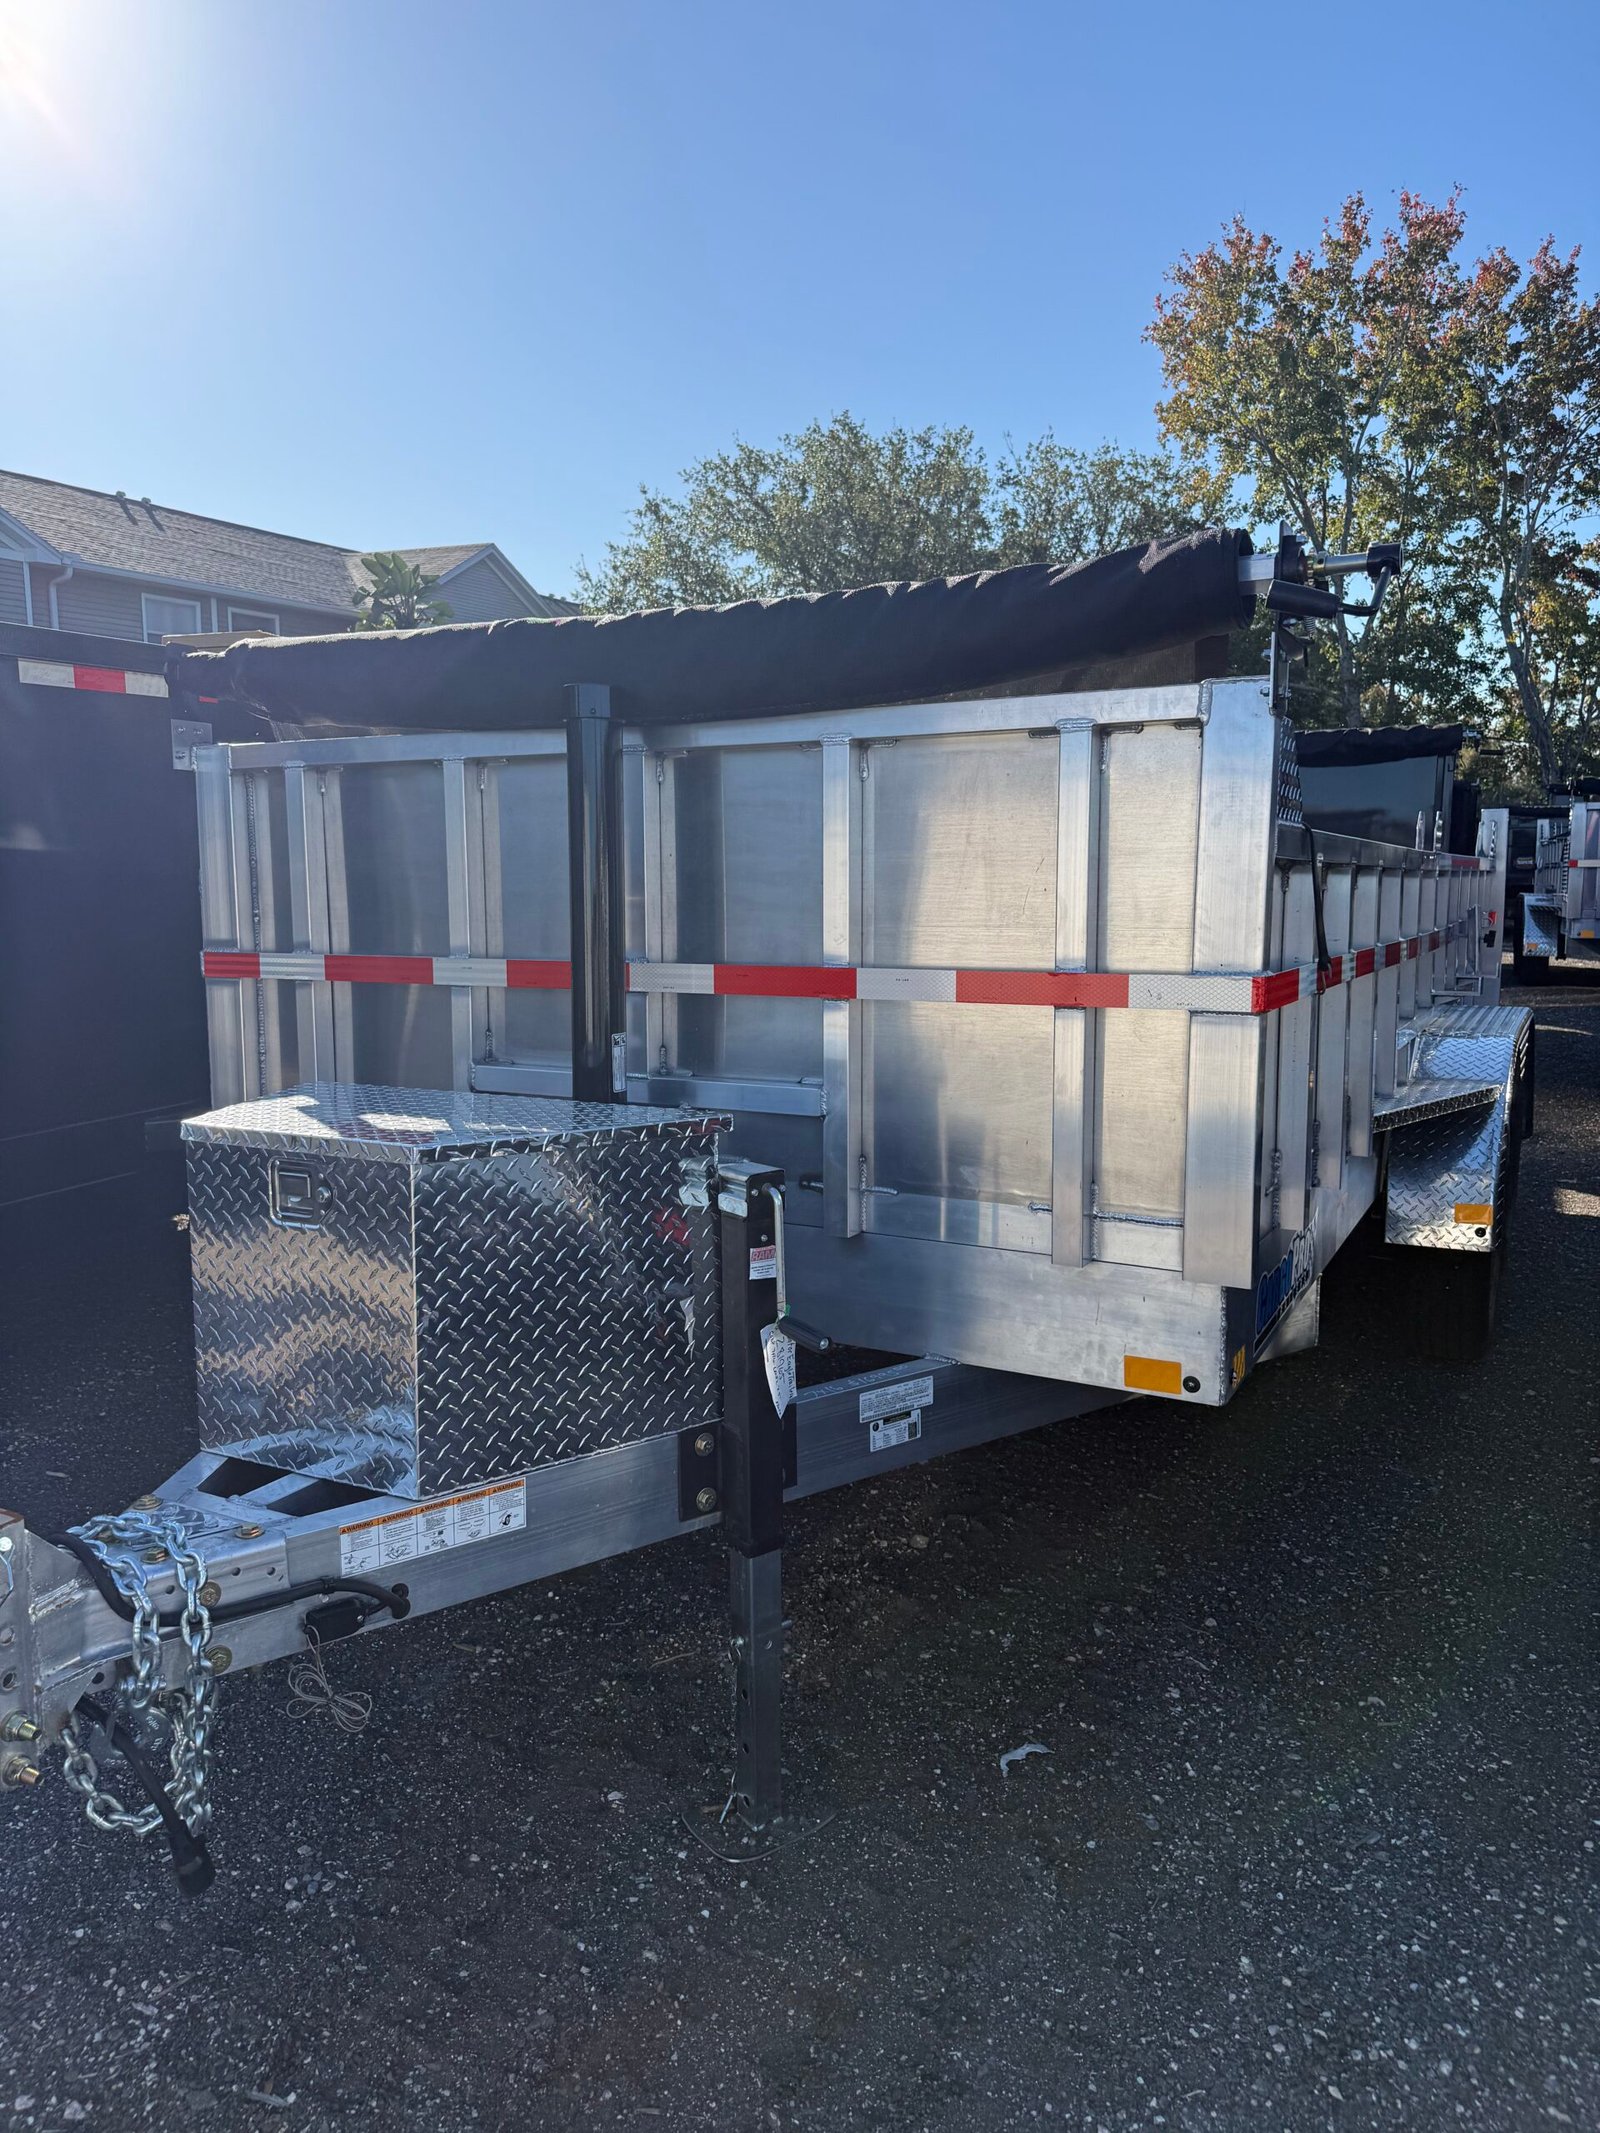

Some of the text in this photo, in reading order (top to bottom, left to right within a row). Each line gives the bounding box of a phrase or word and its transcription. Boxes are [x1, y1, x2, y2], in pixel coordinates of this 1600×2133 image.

[496, 1481, 521, 1492] WARNING
[461, 1490, 487, 1501] WARNING
[425, 1500, 450, 1511] WARNING
[388, 1511, 413, 1521] WARNING
[347, 1520, 374, 1532] WARNING
